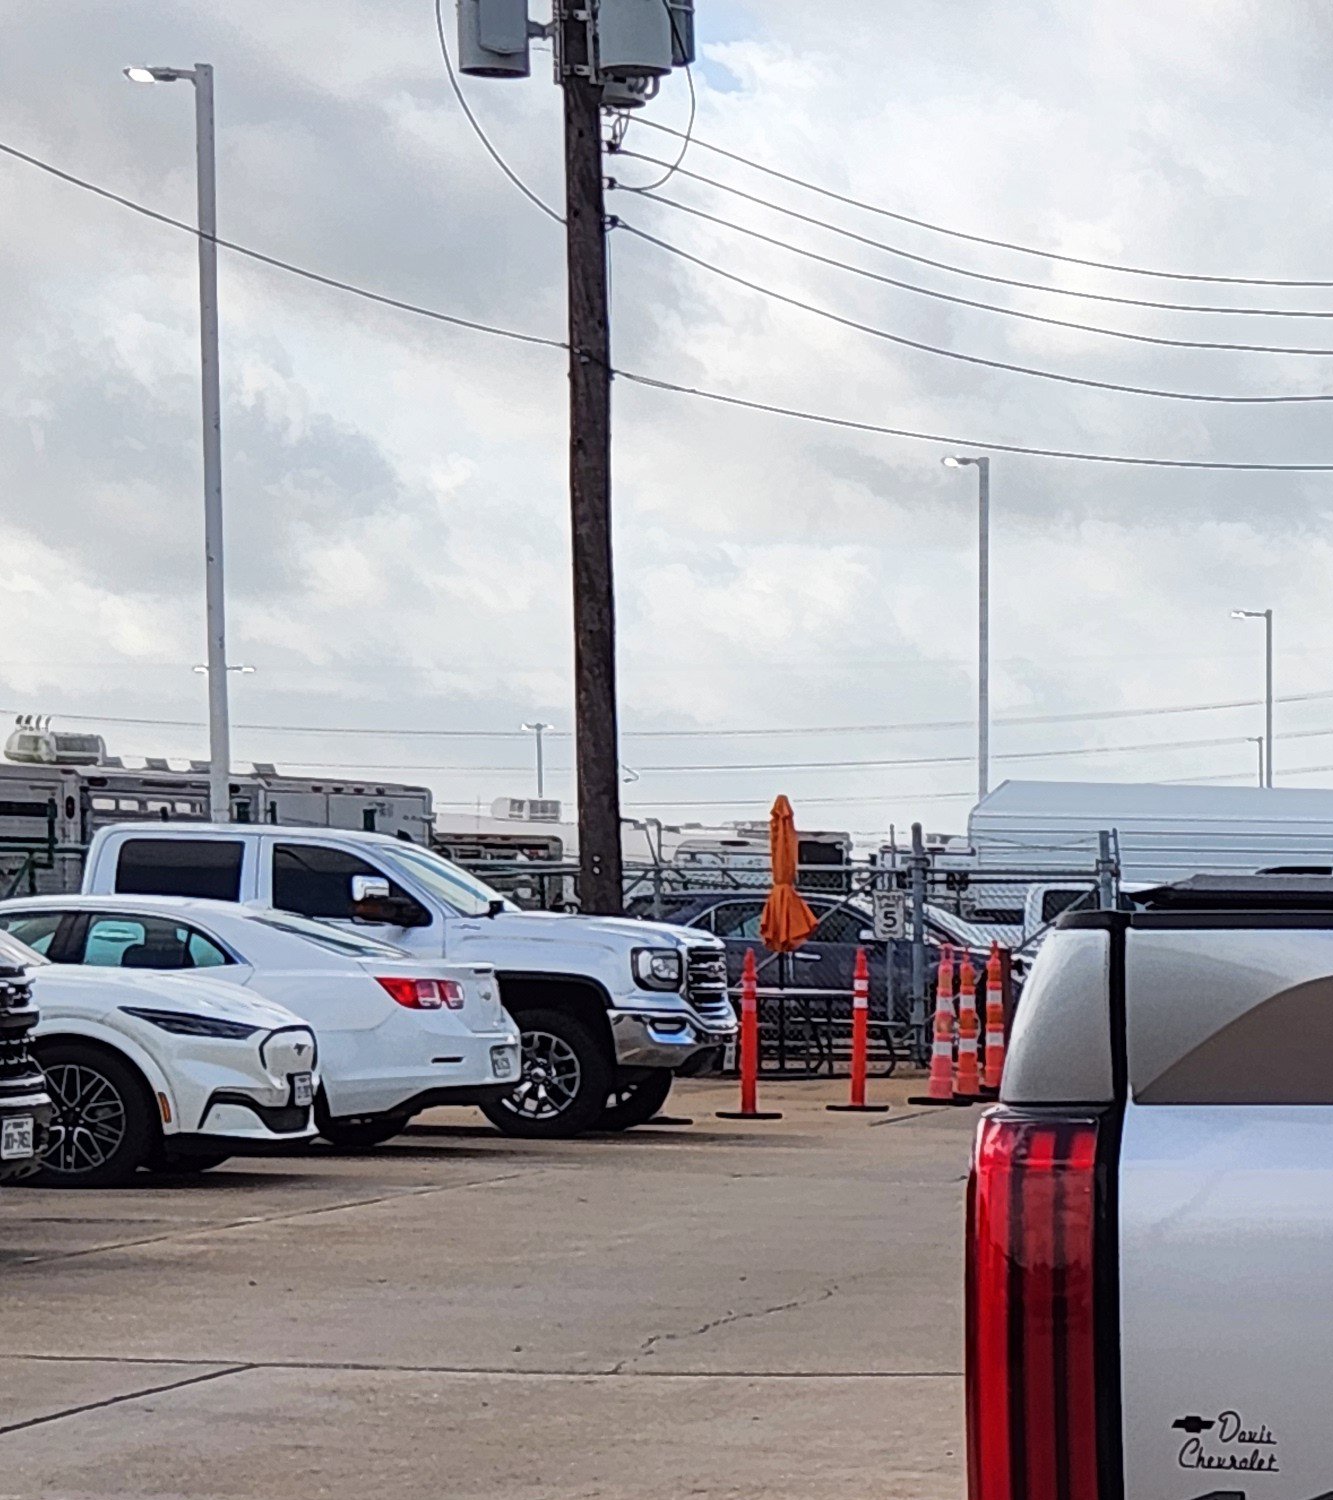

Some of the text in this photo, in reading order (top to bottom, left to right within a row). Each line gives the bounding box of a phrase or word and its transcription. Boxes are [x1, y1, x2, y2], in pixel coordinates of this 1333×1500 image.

[883, 910, 897, 928] 5
[1218, 1410, 1277, 1444] Davis
[1178, 1438, 1279, 1472] Chevrolet
